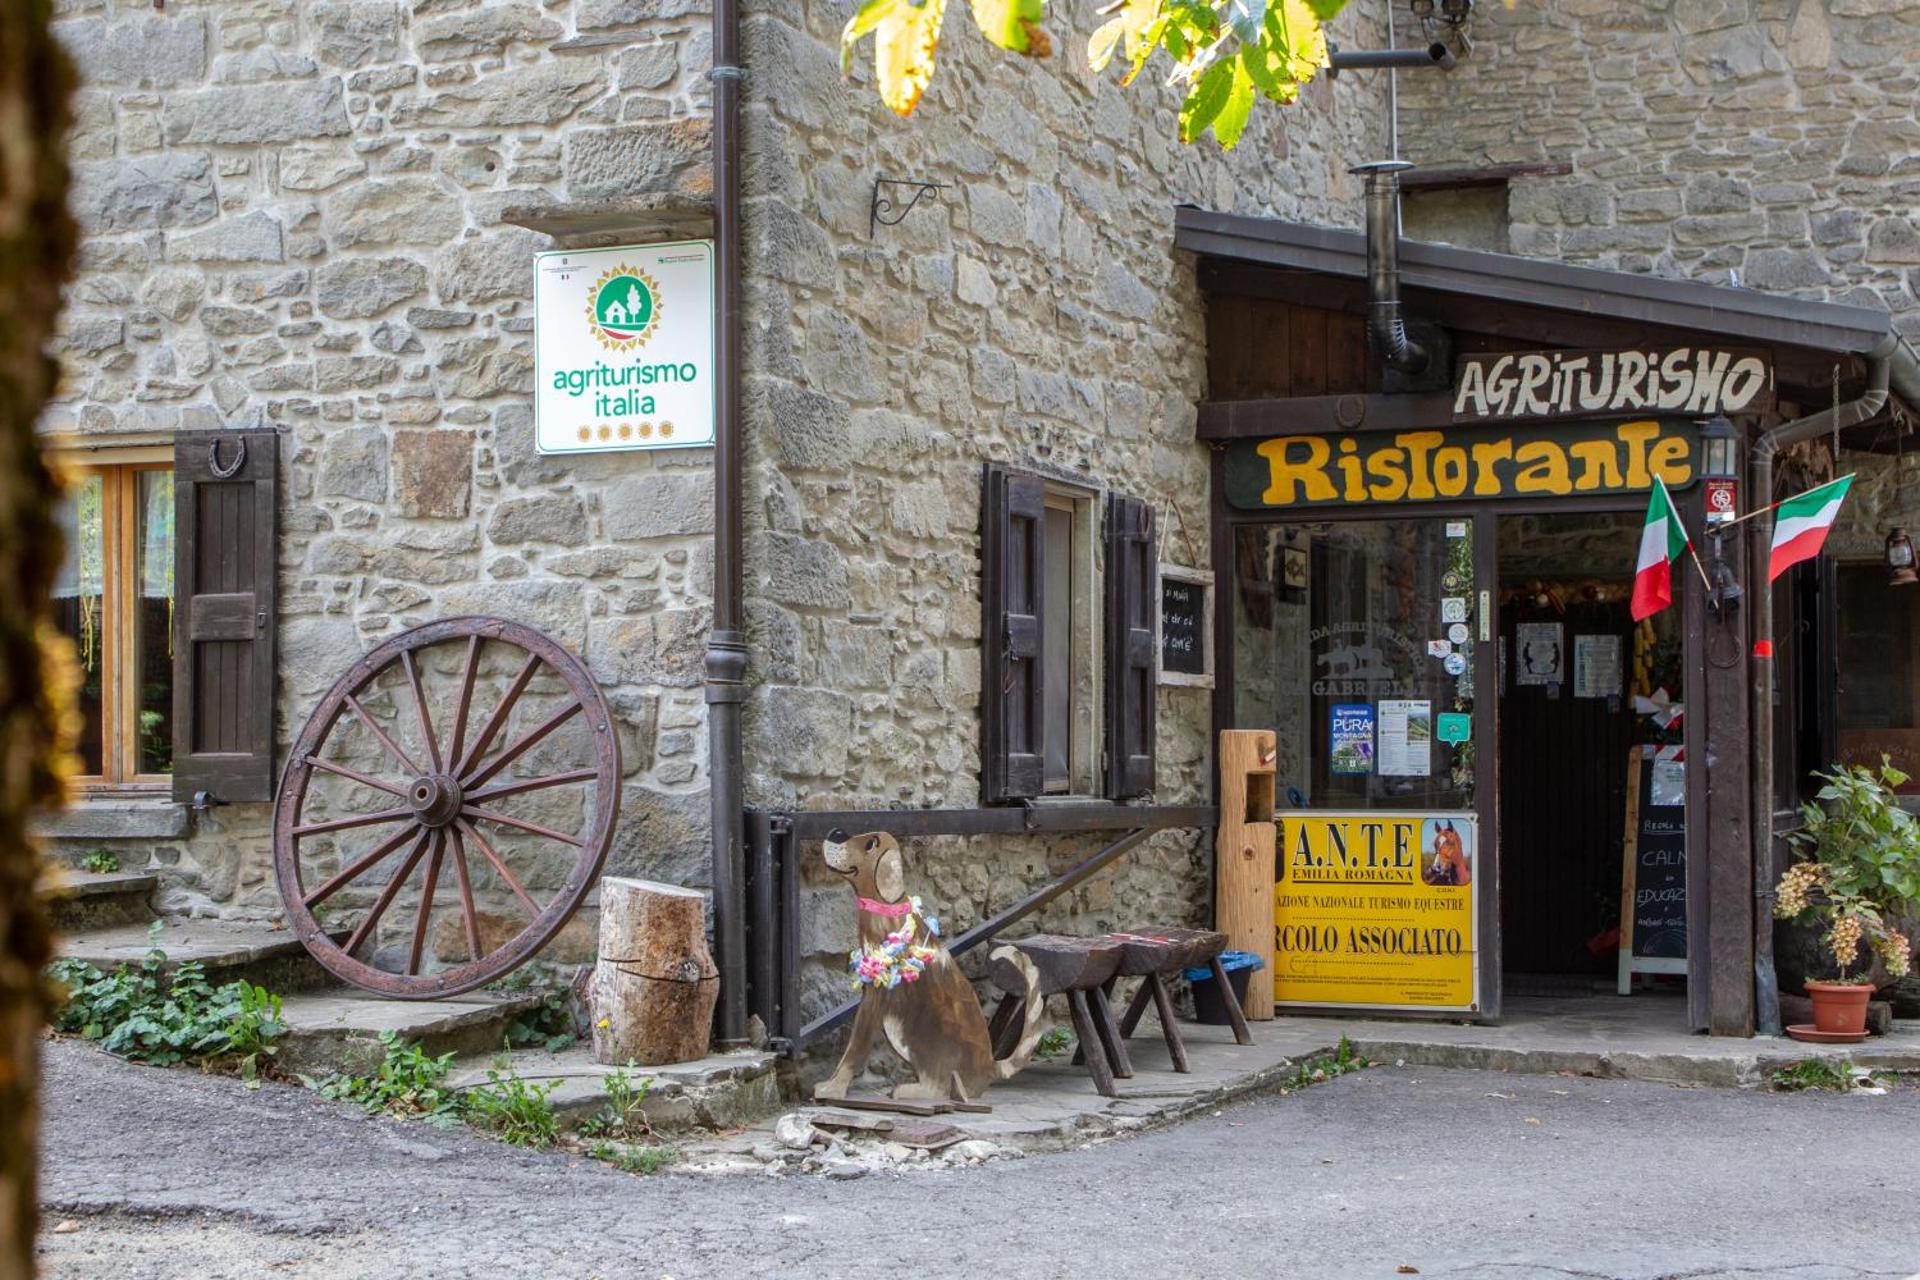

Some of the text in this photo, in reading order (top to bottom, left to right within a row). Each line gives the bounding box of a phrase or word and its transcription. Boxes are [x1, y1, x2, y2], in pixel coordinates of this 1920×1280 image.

[553, 358, 697, 397] agriturismo
[595, 389, 656, 417] italia
[1332, 718, 1371, 731] PURA
[1292, 823, 1414, 869] A.N.T.E
[1292, 869, 1414, 881] EMILIA ROMAGNA
[1313, 896, 1365, 910] NAZIONALE
[1369, 897, 1411, 911] TURISMO
[1414, 898, 1464, 914] EQUESTRE
[1345, 926, 1462, 957] ASSOCIATO
